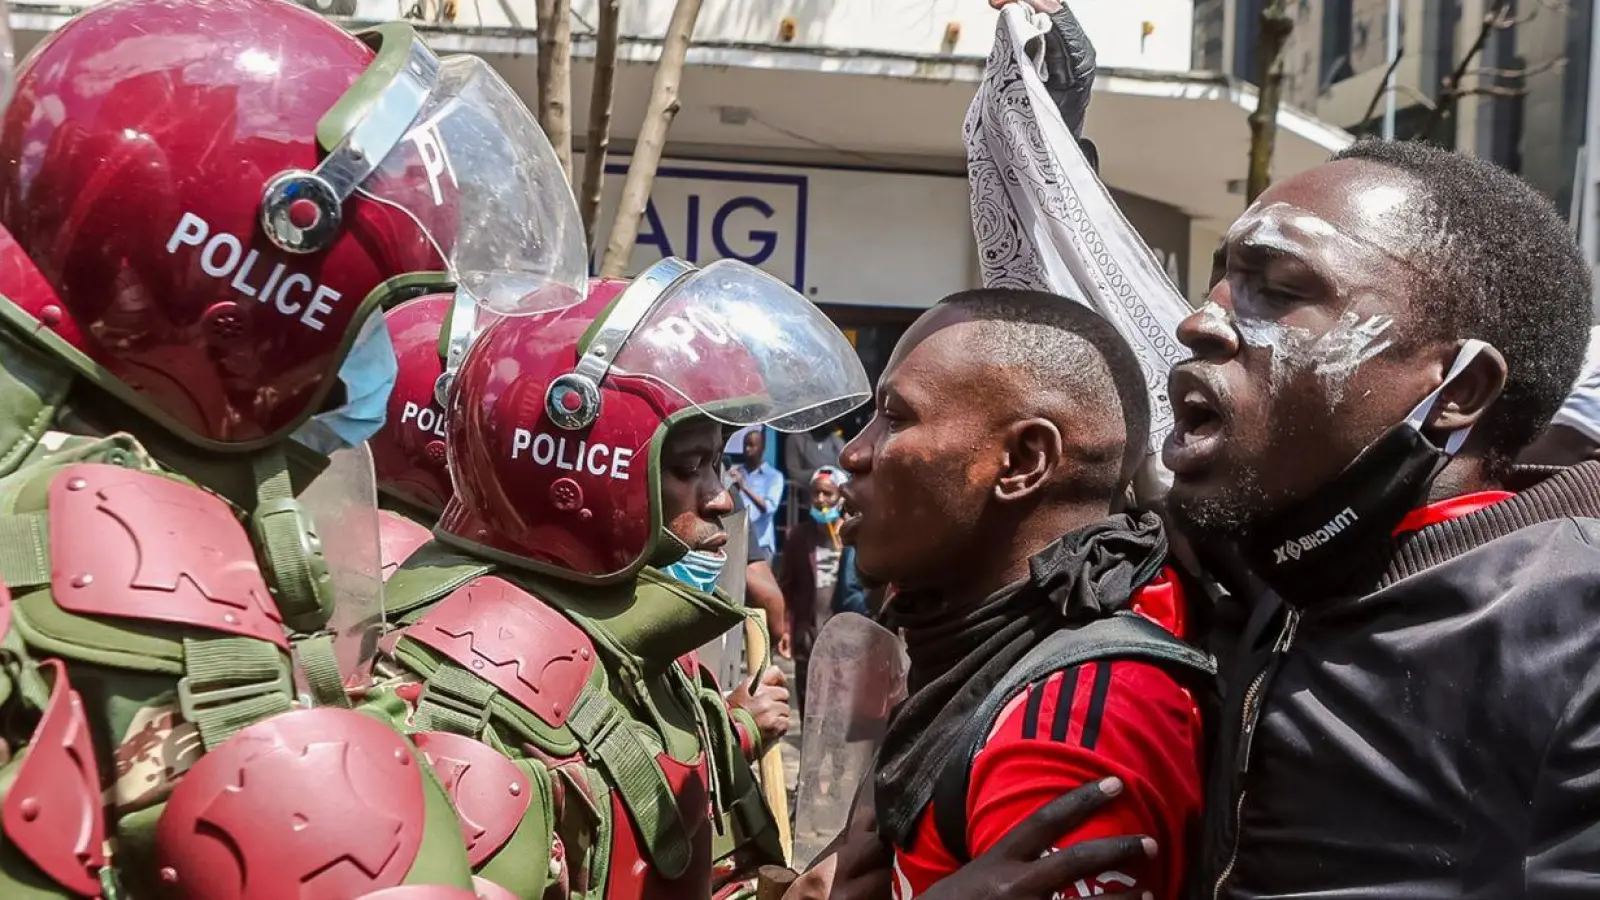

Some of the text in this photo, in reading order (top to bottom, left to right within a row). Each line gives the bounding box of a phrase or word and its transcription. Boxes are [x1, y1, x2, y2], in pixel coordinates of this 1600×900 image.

[636, 194, 777, 266] AIG
[166, 212, 342, 331] POLICE
[512, 428, 634, 480] POLICE
[1273, 506, 1359, 564] LUNCHBOX
